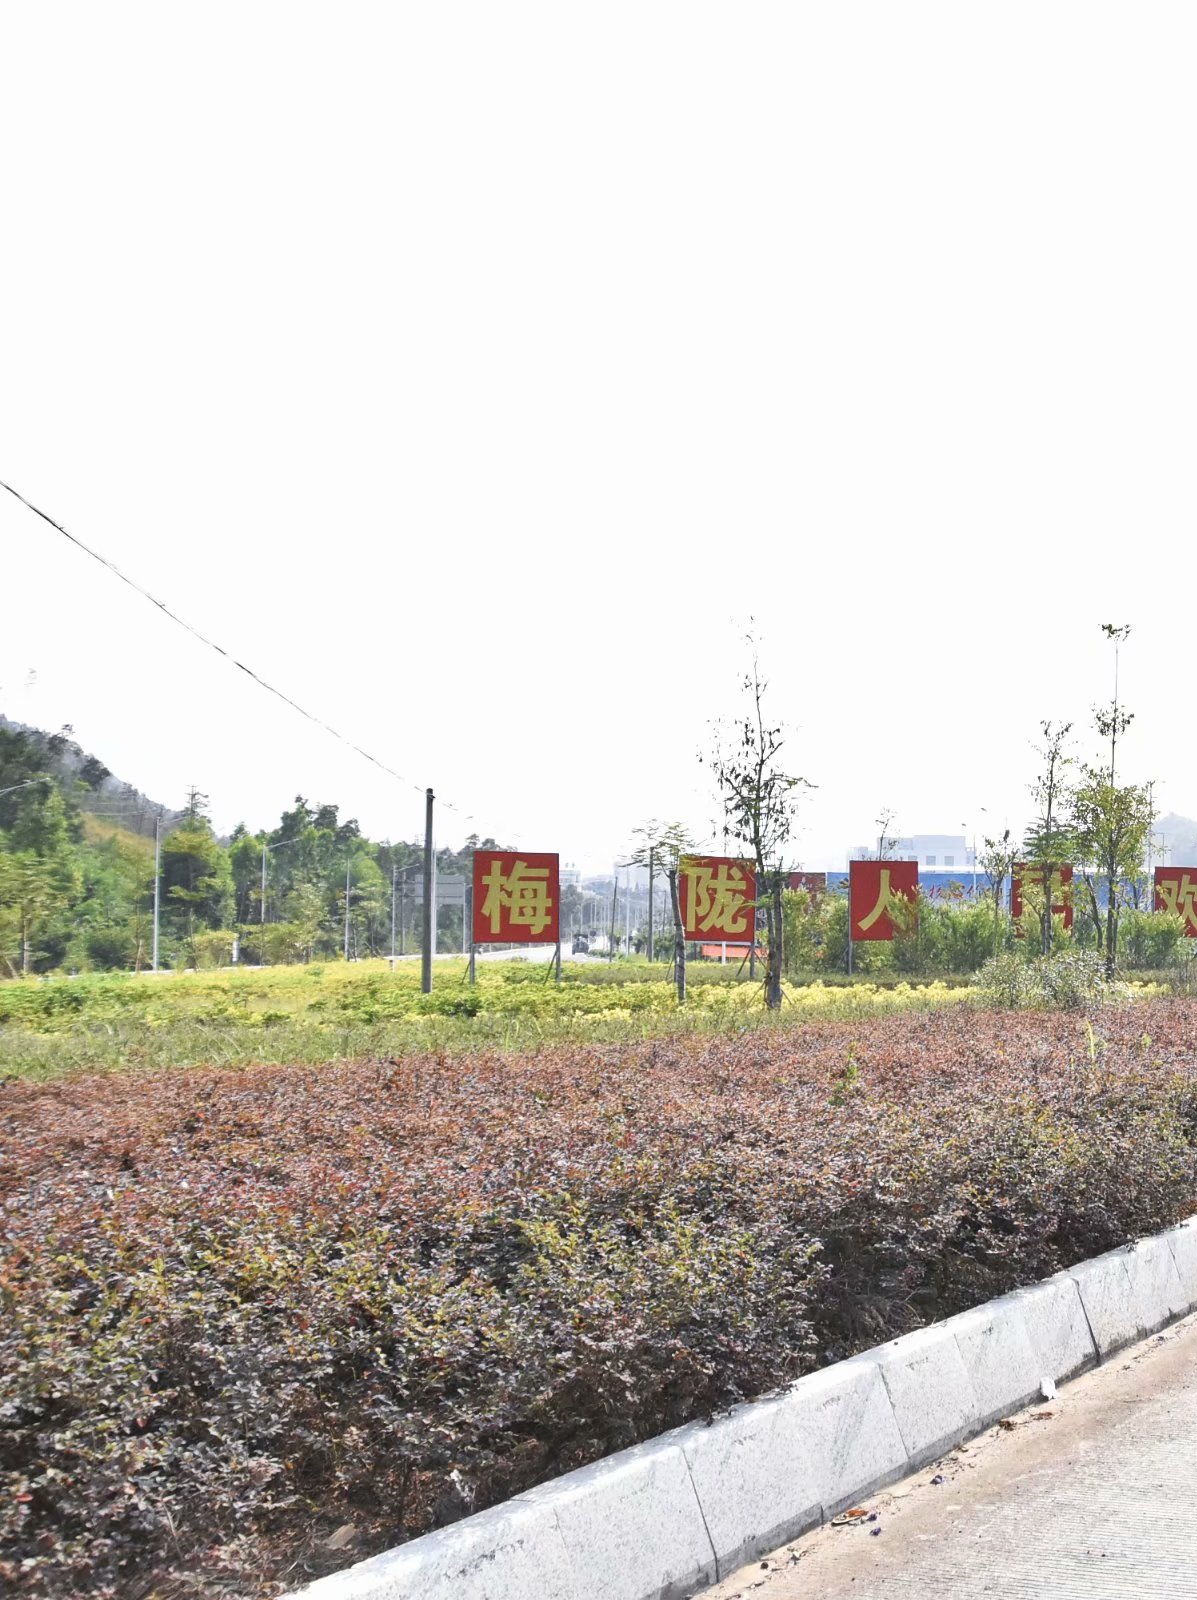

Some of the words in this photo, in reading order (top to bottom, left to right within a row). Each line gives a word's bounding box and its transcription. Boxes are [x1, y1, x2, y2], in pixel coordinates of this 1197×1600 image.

[481, 860, 552, 935] 梅
[686, 865, 747, 934] 陇
[857, 868, 907, 932] 人
